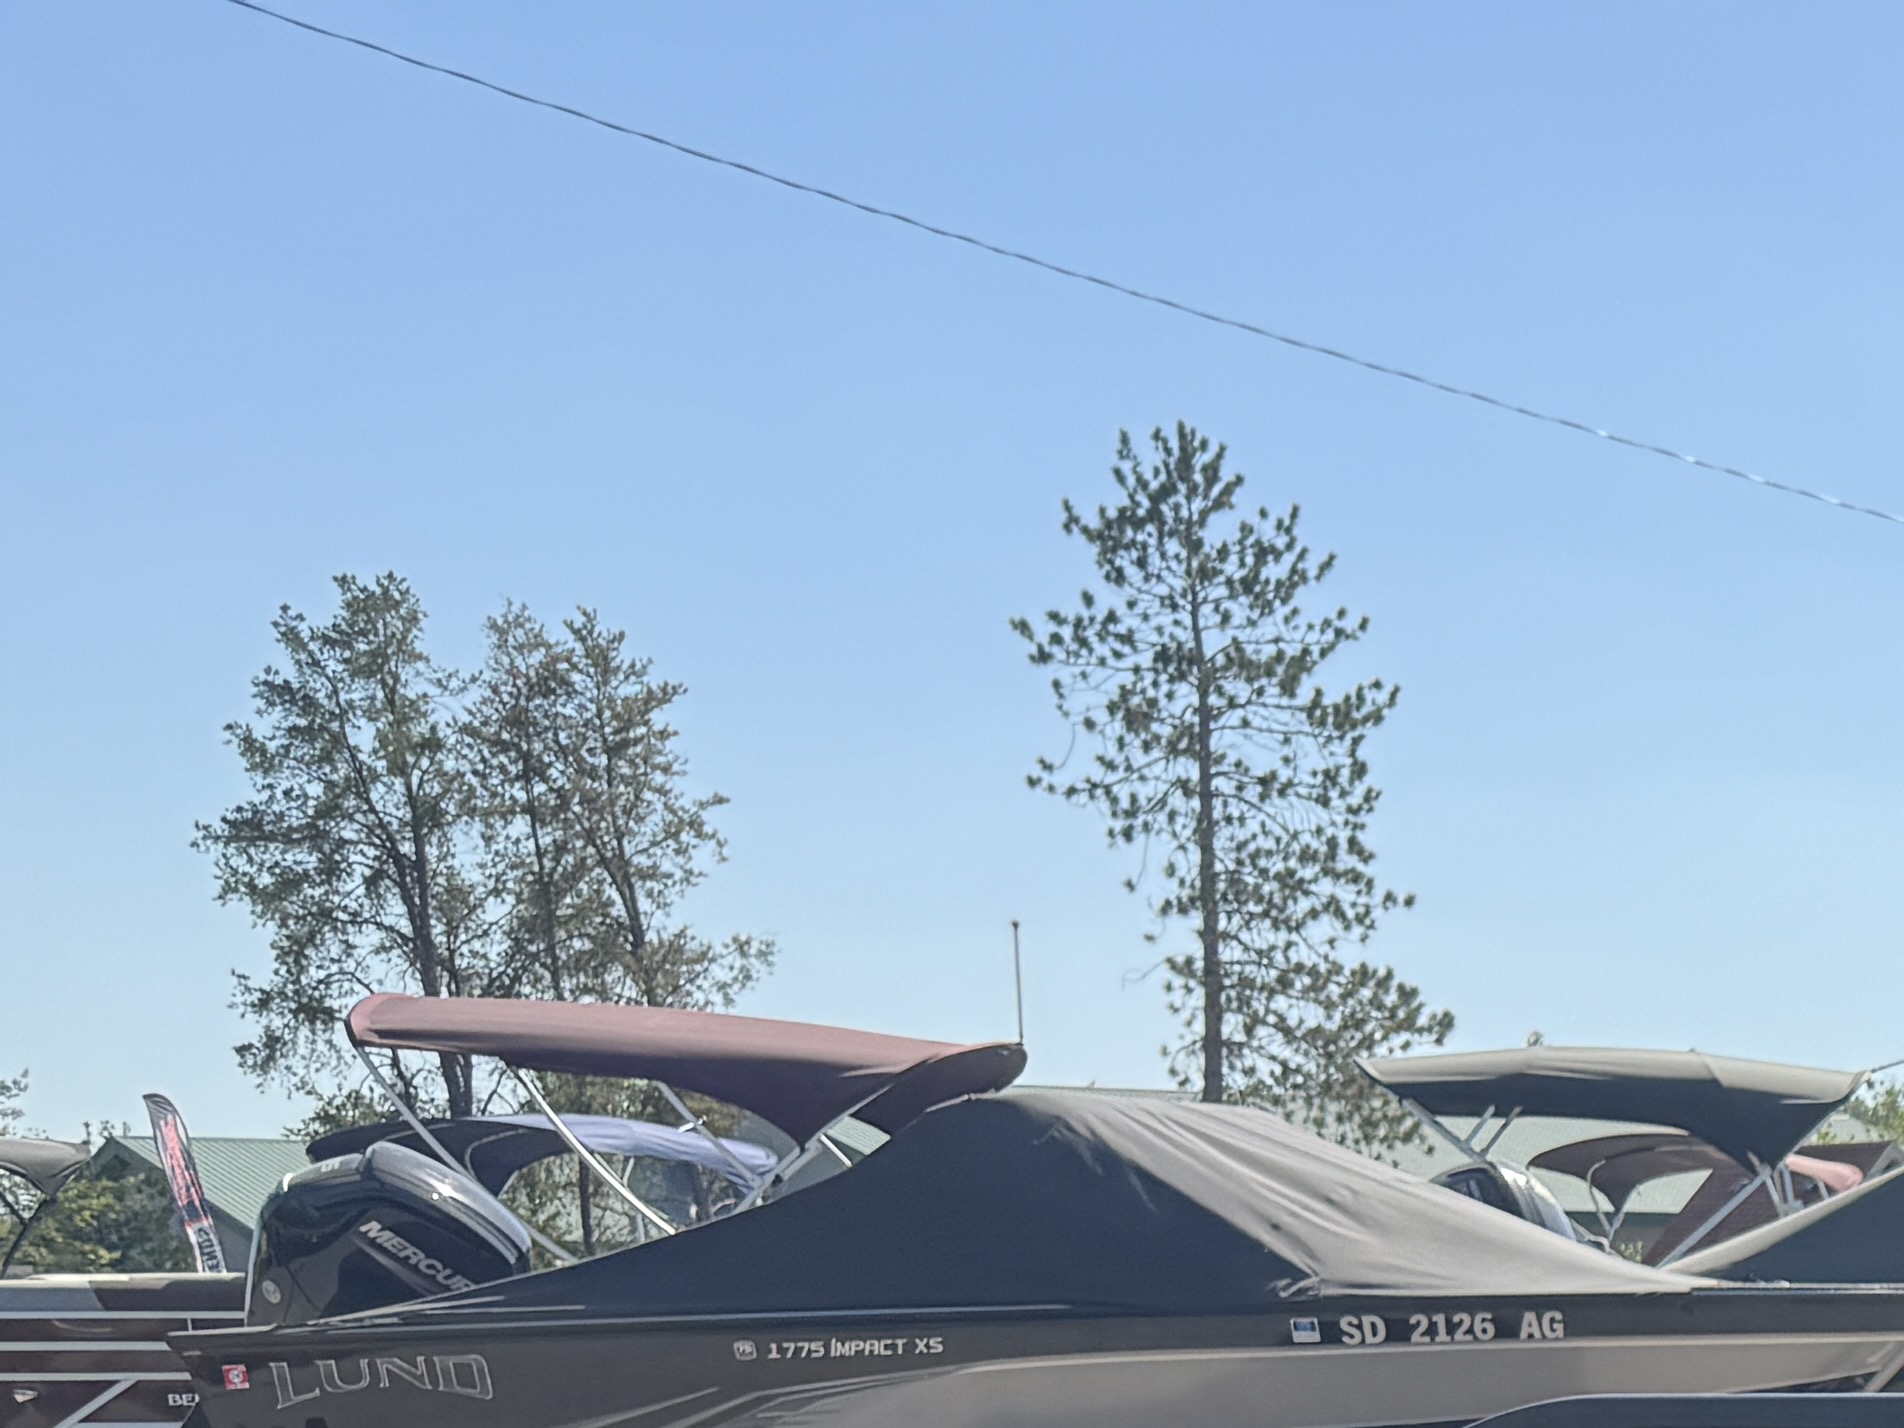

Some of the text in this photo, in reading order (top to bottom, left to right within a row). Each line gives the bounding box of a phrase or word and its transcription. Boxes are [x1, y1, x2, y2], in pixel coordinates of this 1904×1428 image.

[358, 1219, 477, 1292] MERCUR
[1339, 1311, 1564, 1345] SD 2126 AG
[766, 1341, 825, 1359] 1775
[830, 1337, 908, 1357] IMPACT
[914, 1337, 944, 1355] XS
[268, 1353, 494, 1410] LUND
[167, 1393, 200, 1407] BE
